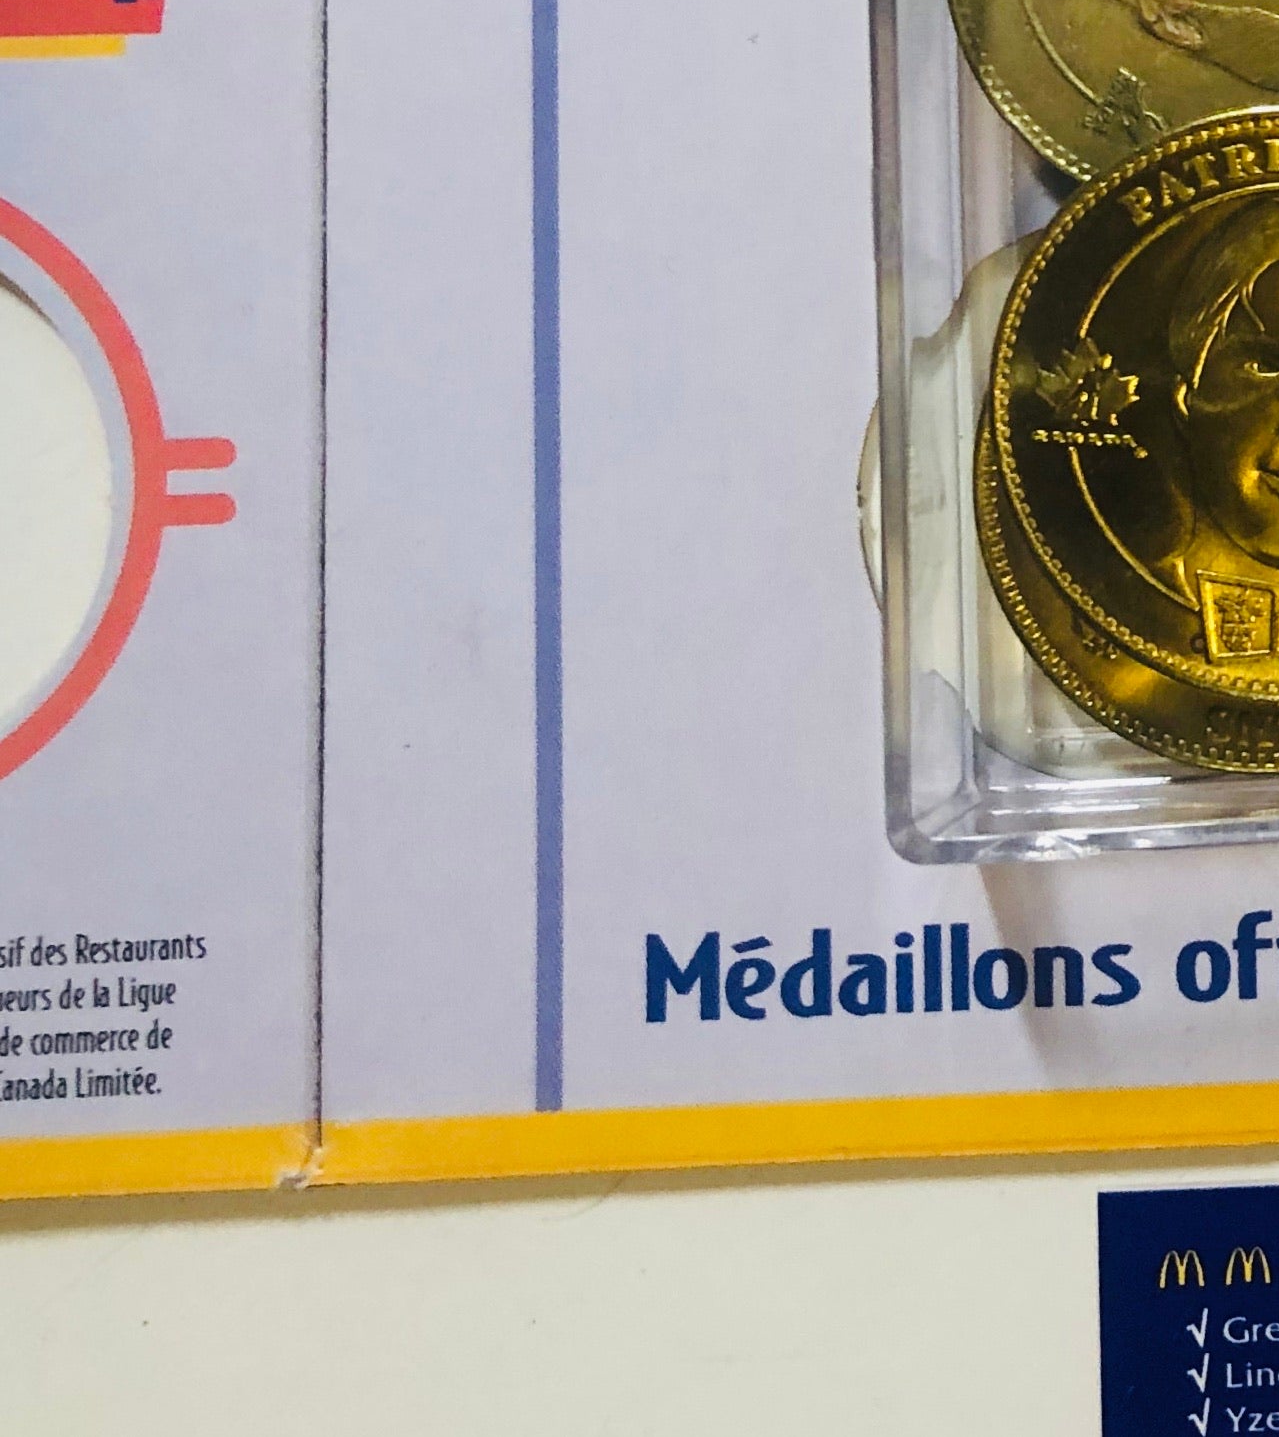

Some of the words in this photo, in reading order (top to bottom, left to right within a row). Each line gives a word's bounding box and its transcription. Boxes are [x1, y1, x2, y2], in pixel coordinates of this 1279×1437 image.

[30, 935, 68, 966] des
[75, 933, 208, 964] Restaurants
[645, 922, 1142, 1024] Médaillons
[58, 978, 86, 1010] de
[93, 977, 111, 1008] la
[117, 976, 177, 1012] Ligue
[0, 1026, 24, 1057] de
[30, 1028, 140, 1056] commerce
[146, 1018, 174, 1050] de
[75, 1066, 163, 1099] Limitée.
